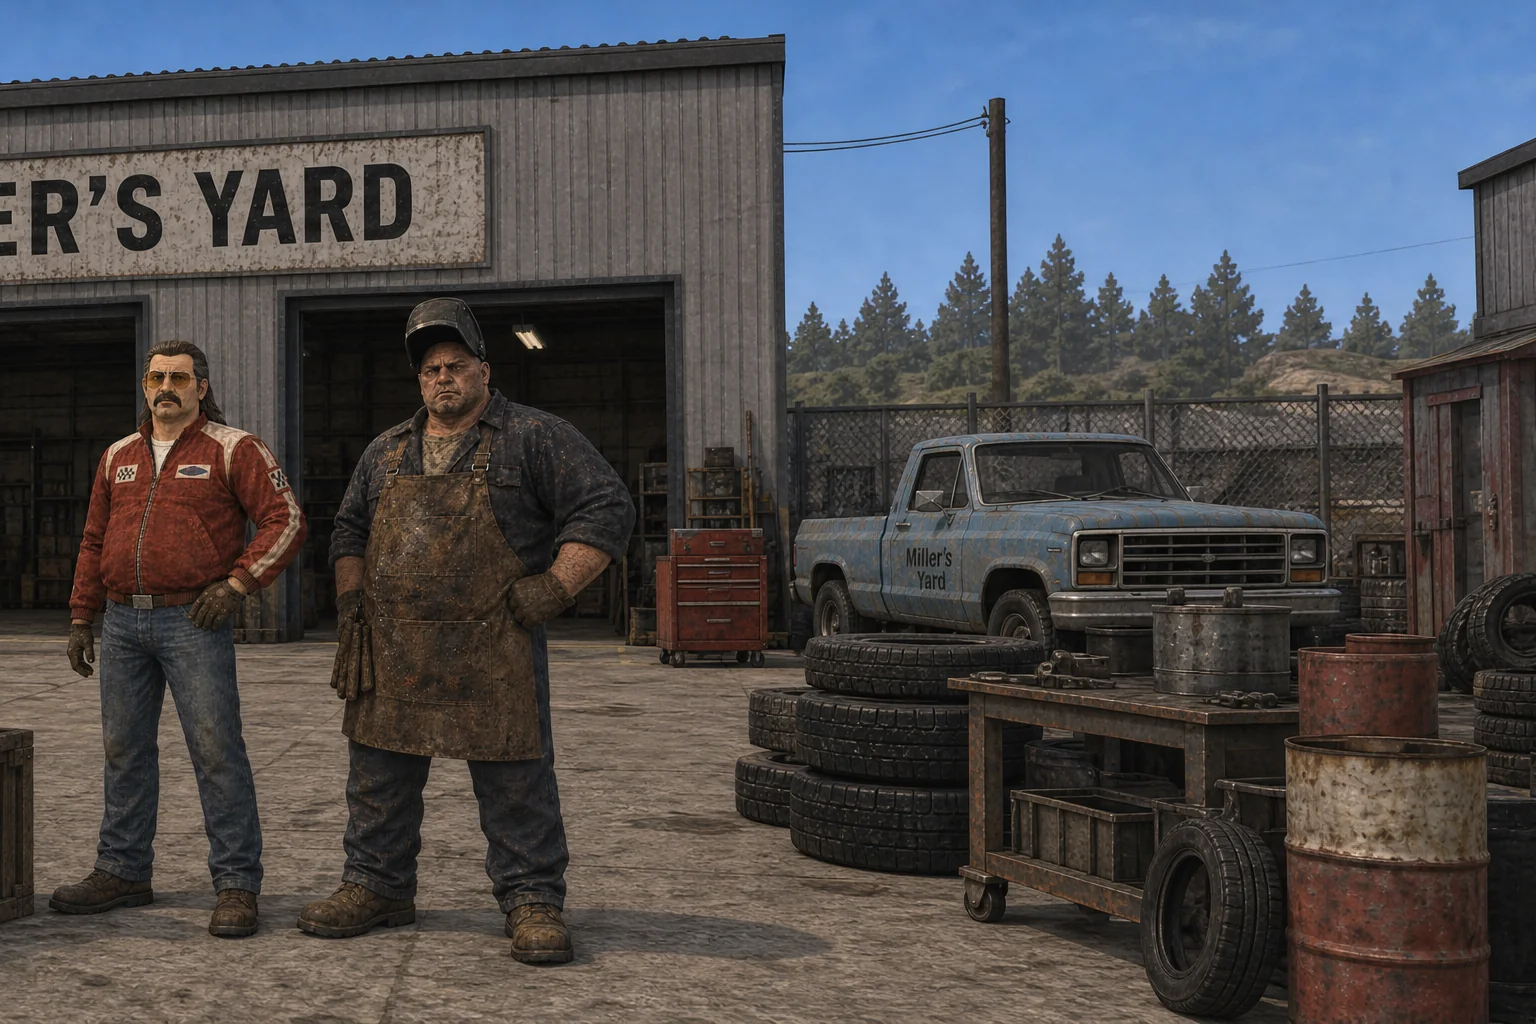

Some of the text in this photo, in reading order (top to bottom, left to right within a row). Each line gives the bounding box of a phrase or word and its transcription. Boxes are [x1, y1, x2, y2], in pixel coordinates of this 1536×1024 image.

[194, 163, 413, 247] YARD
[906, 547, 952, 567] Miller's
[917, 571, 946, 590] Yard
